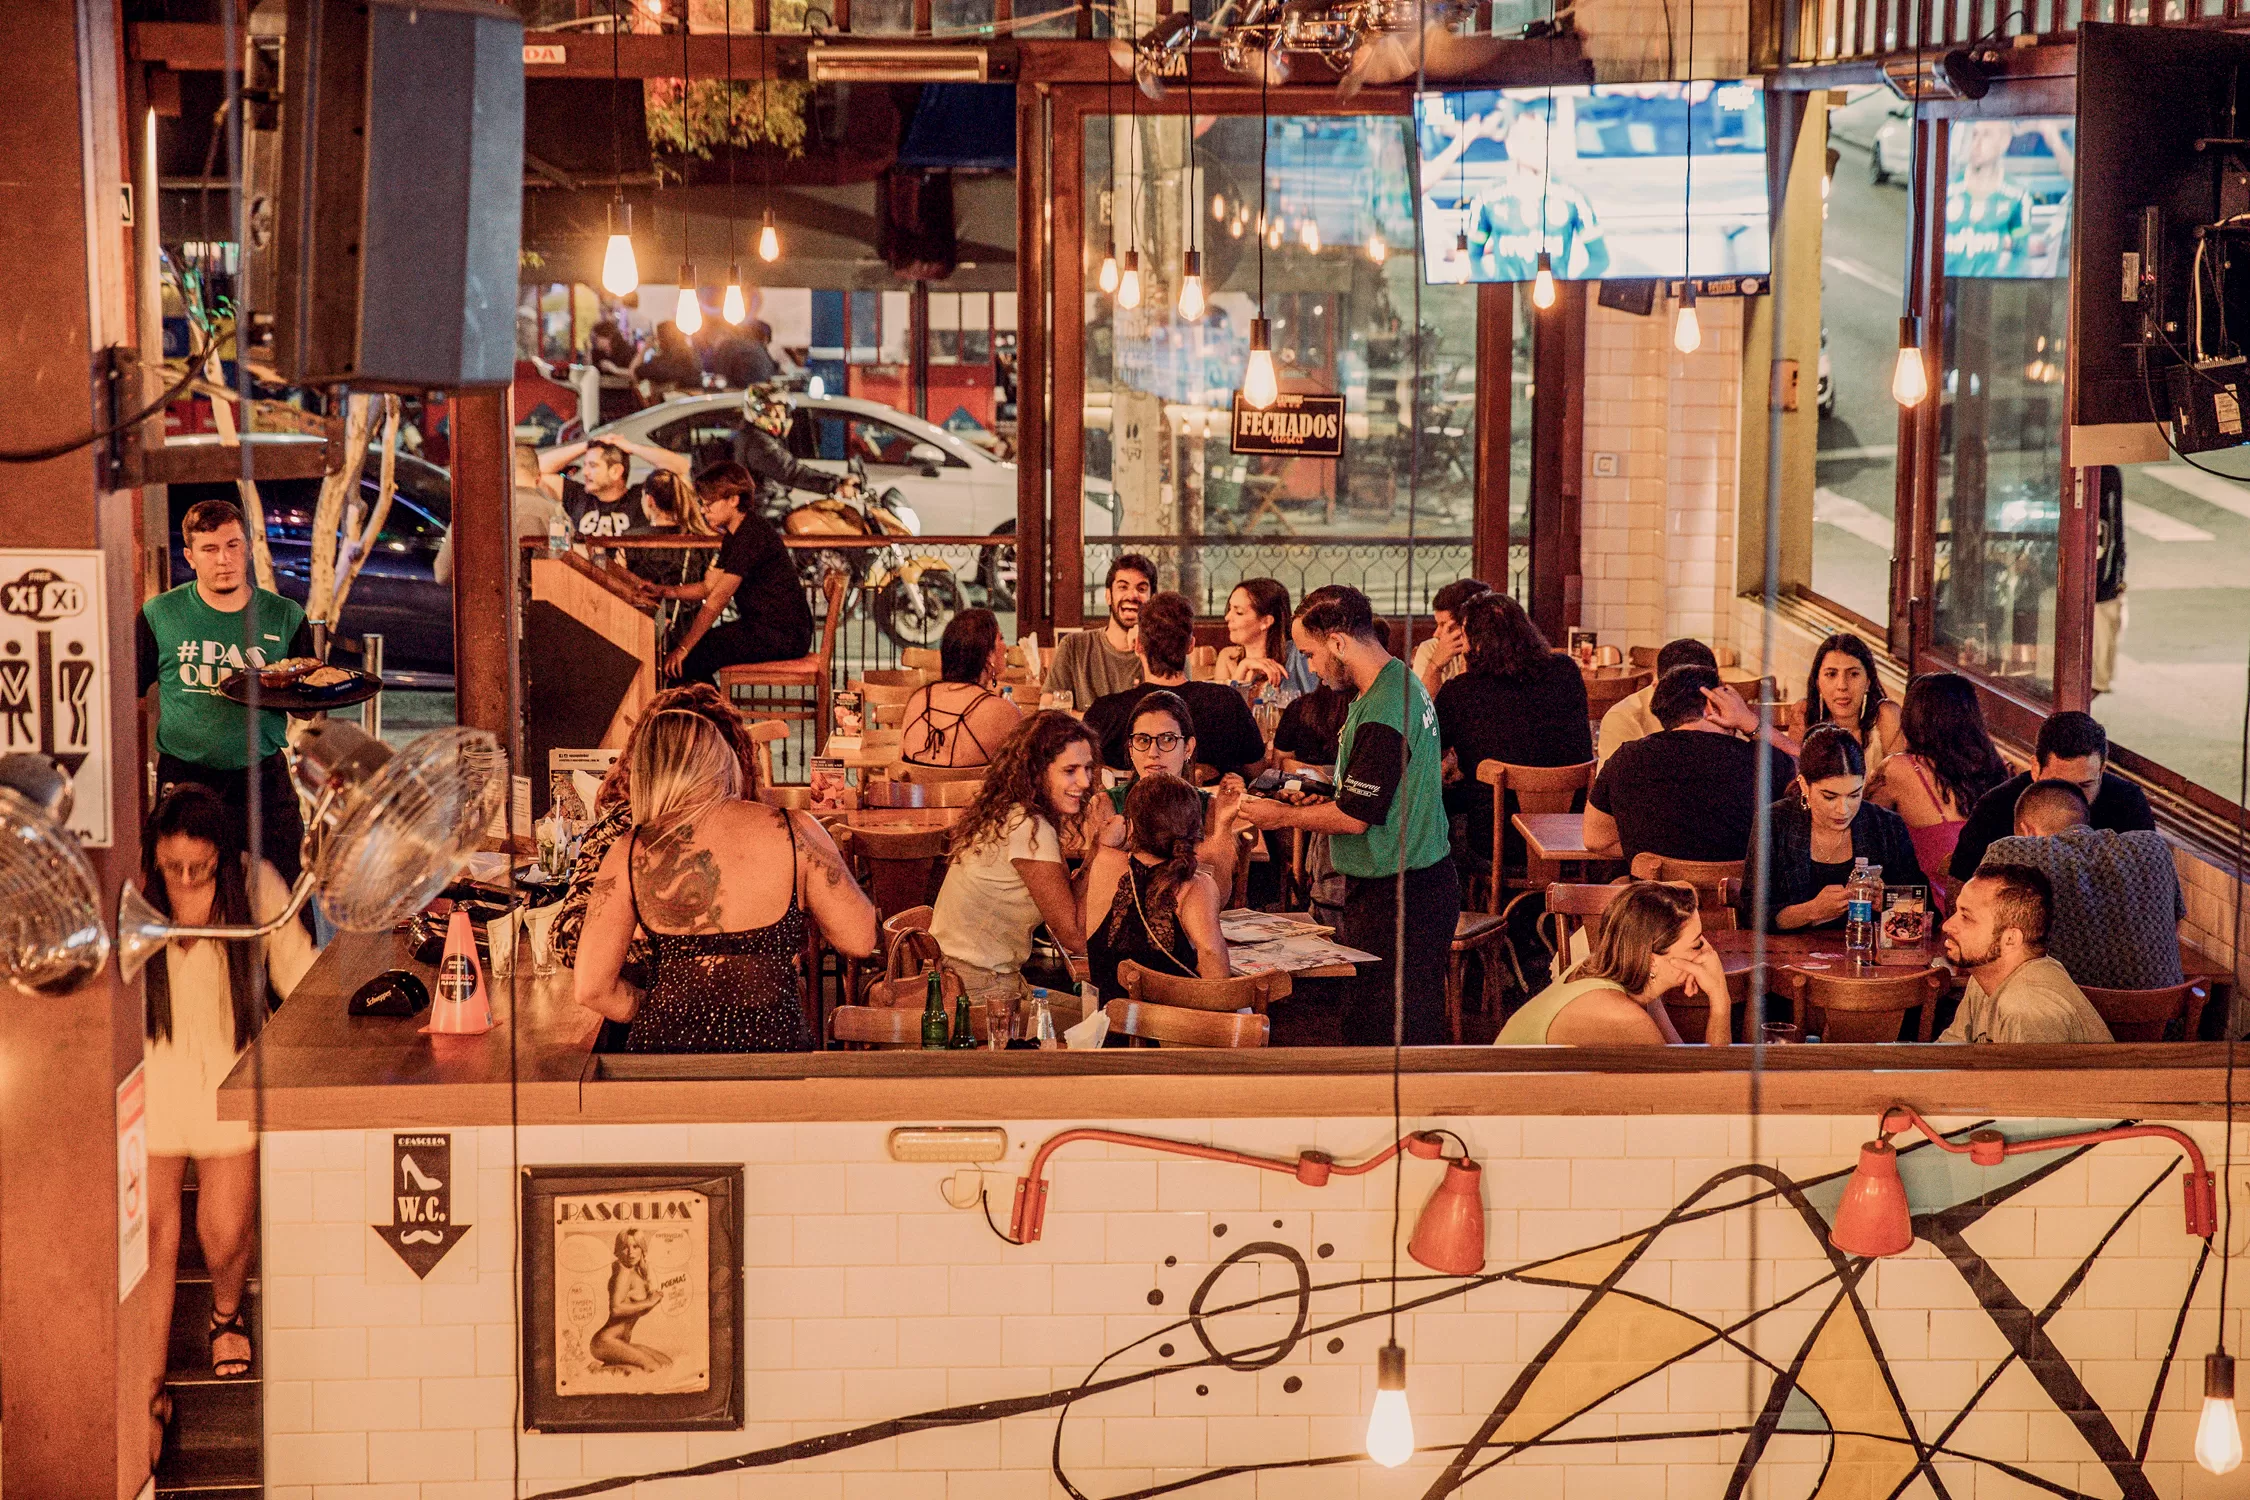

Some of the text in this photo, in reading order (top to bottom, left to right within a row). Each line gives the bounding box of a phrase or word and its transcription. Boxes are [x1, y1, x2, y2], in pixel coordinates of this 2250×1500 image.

[1240, 411, 1337, 439] FECHADOS
[579, 509, 630, 537] GAP
[7, 585, 77, 613] Xi Xi
[1345, 774, 1381, 793] Tanqueray
[397, 1196, 446, 1222] W.C.
[561, 1201, 692, 1221] PASQUIM
[661, 1273, 686, 1290] POEMAS
